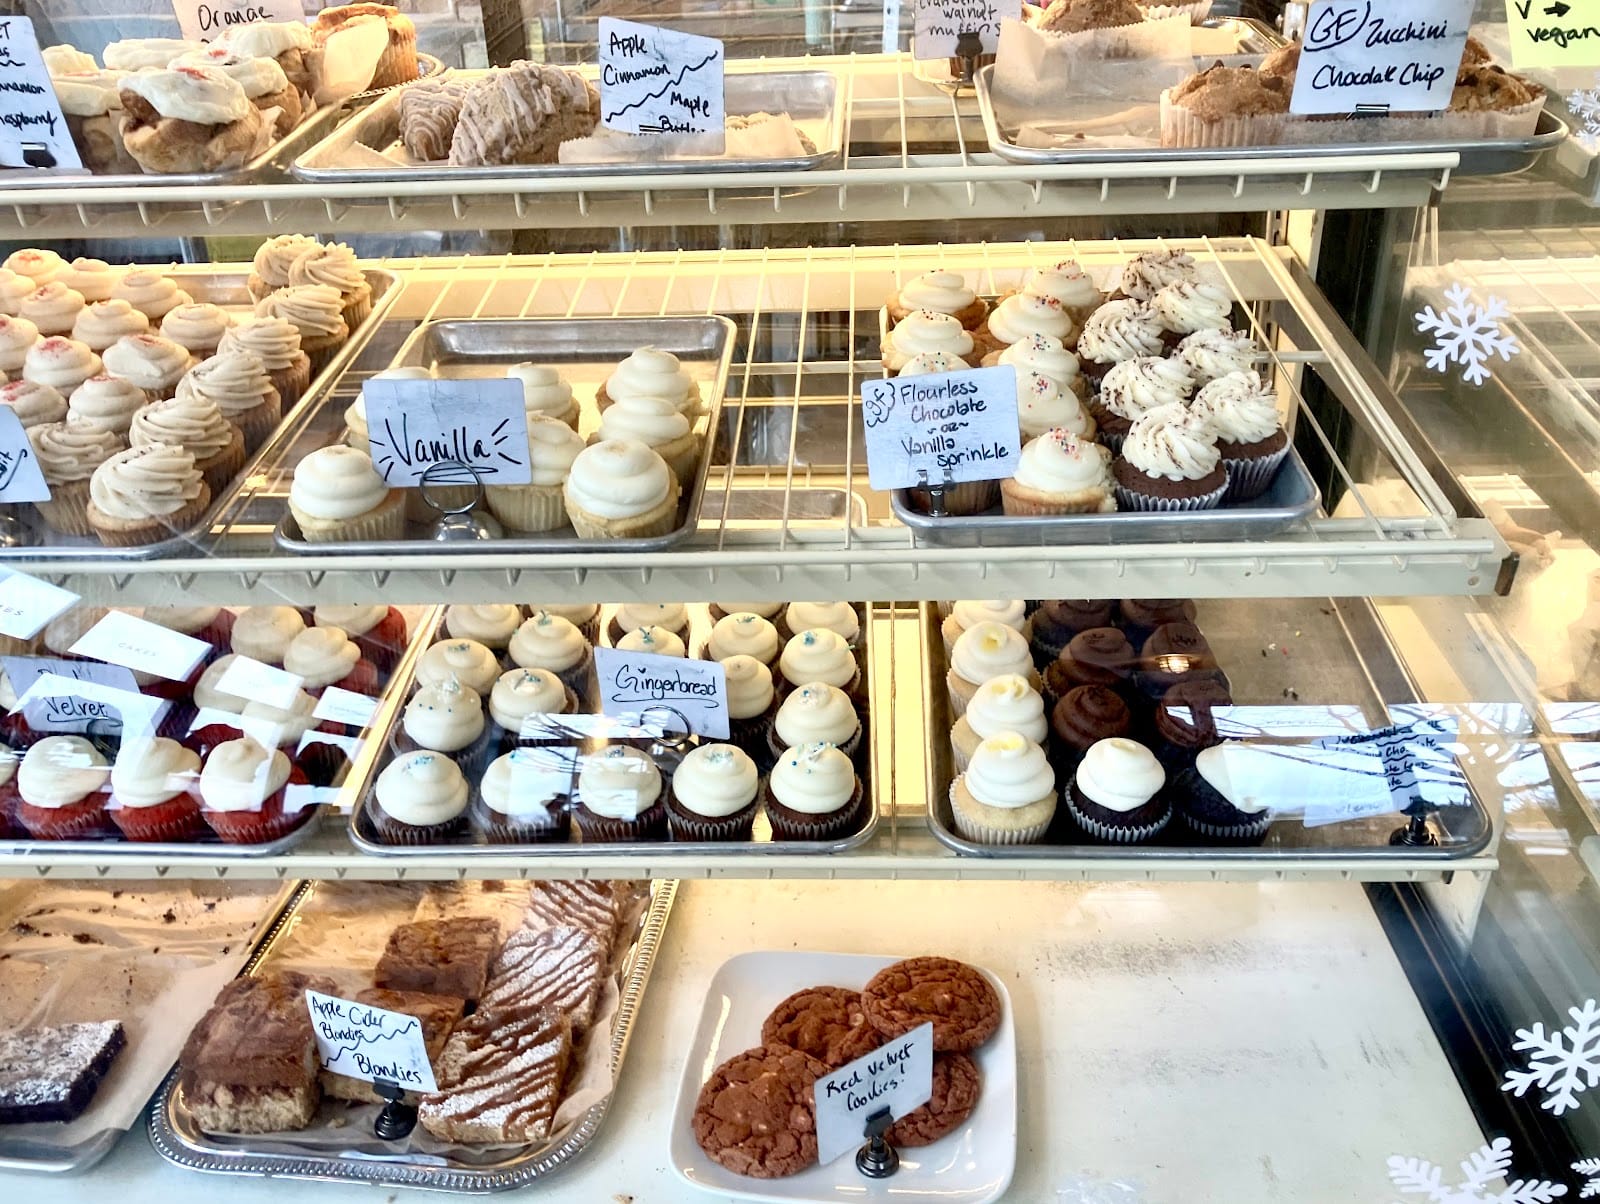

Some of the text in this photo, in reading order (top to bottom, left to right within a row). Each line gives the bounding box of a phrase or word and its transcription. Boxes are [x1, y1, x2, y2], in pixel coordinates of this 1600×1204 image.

[943, 4, 998, 21] walnut
[608, 31, 647, 58] Apple
[1365, 18, 1448, 48] Zucchini
[1526, 26, 1600, 48] vegan
[603, 63, 671, 86] Cinnamon
[1399, 62, 1445, 91] Chip
[671, 90, 710, 119] Maple
[900, 379, 979, 405] Flourless
[911, 398, 987, 424] Chocolate
[384, 412, 491, 467] Vanilla
[901, 435, 956, 458] Vanilla
[937, 442, 1009, 470] sprinkle
[615, 664, 717, 700] Gingerbread
[312, 995, 386, 1028] Apple Cider
[319, 1021, 363, 1042] Blondies
[352, 1053, 423, 1084] Blondies
[826, 1042, 914, 1098] Red Velvet
